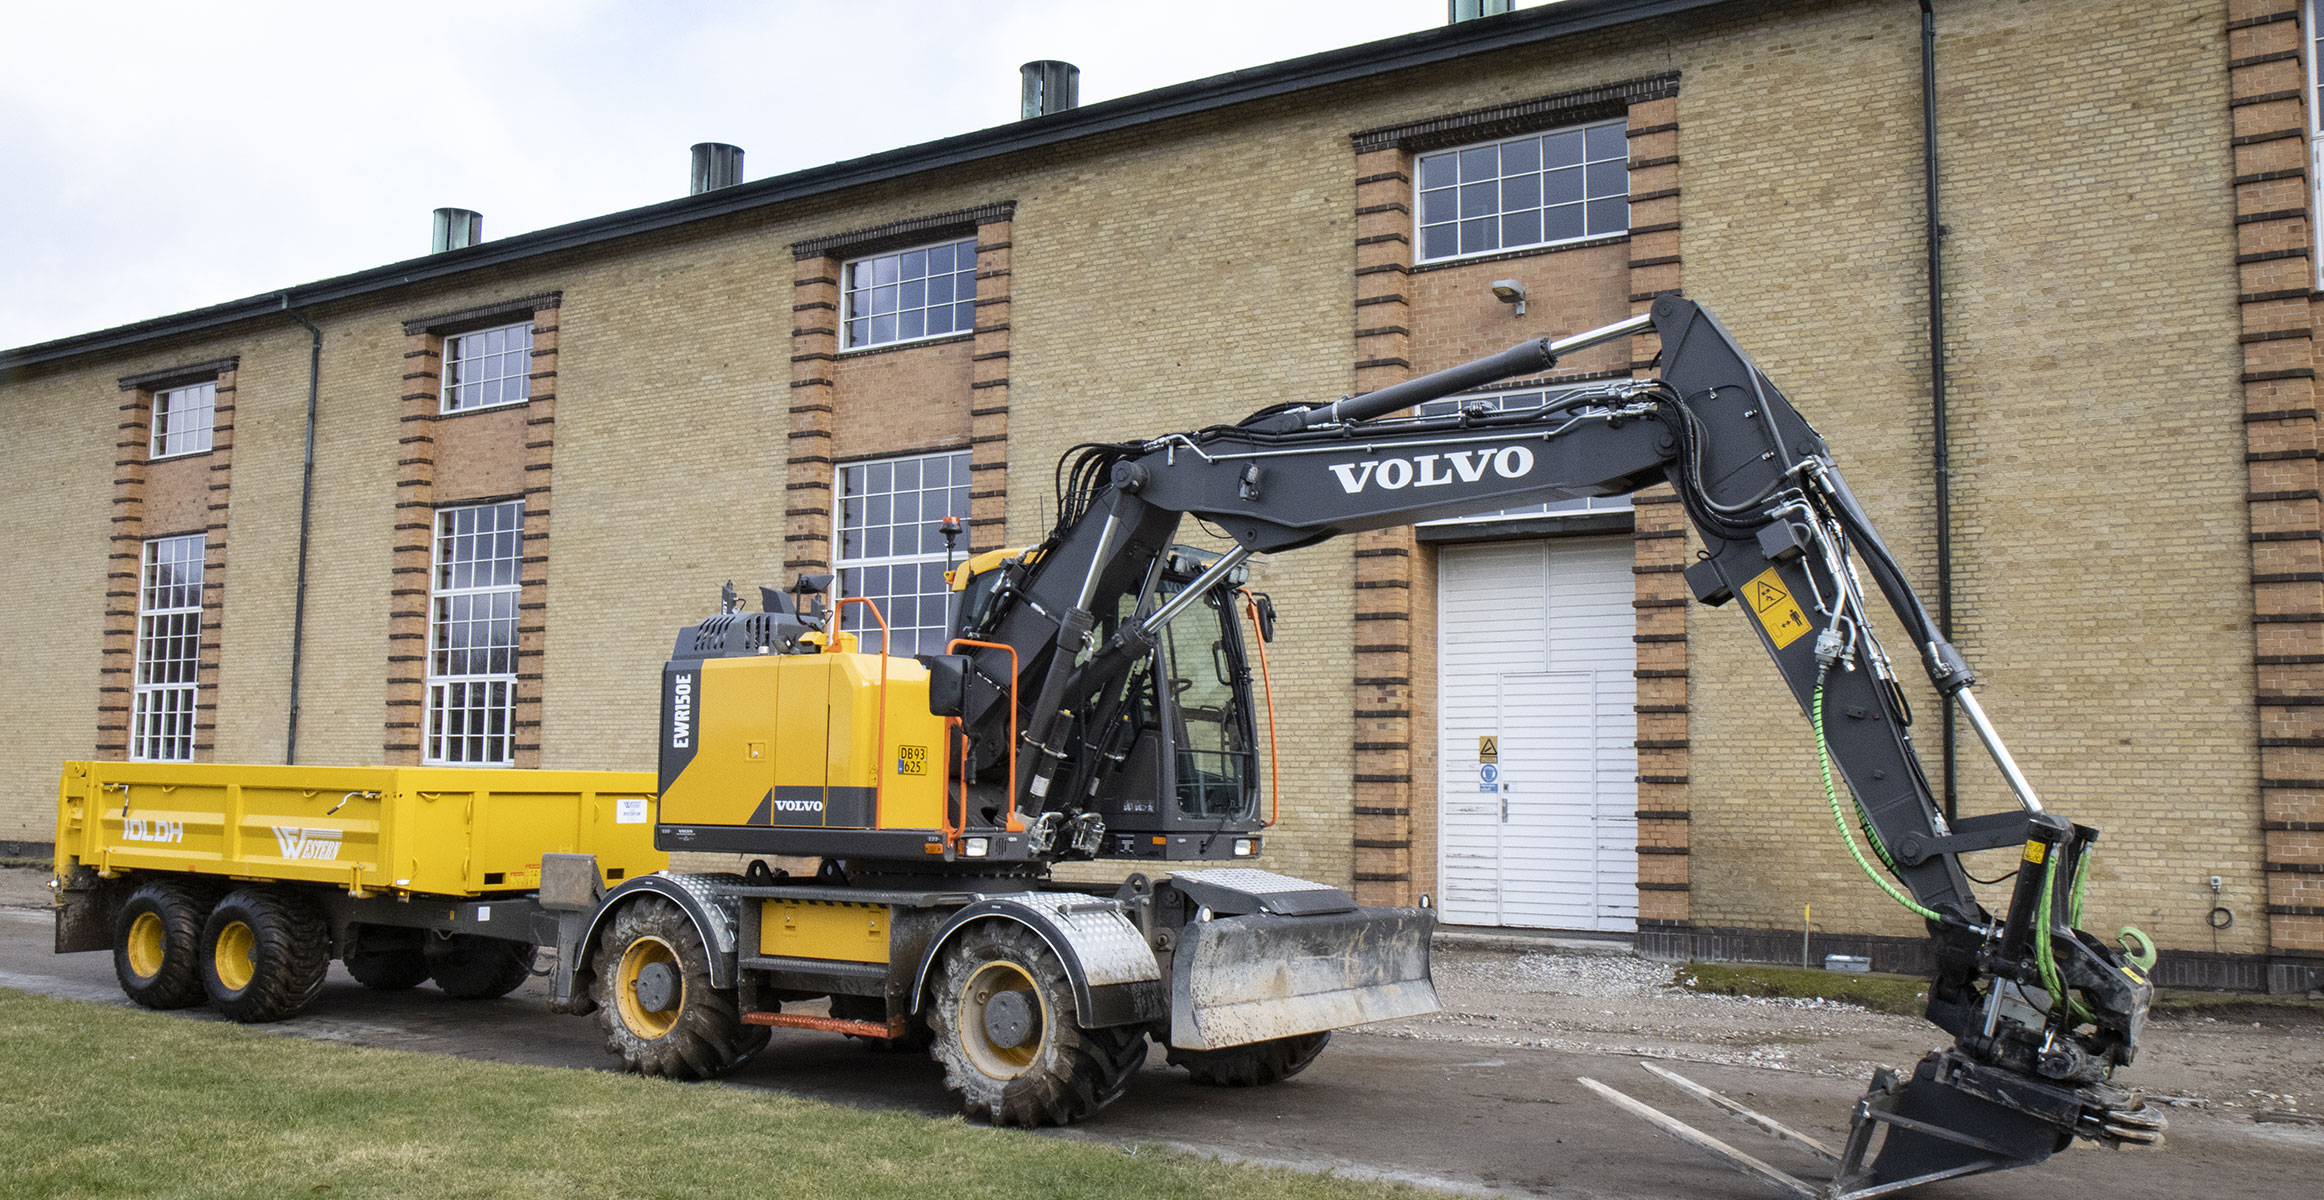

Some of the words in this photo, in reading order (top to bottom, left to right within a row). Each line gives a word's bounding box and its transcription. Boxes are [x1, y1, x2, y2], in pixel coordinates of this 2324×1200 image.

[1328, 445, 1534, 494] VOLVO
[673, 674, 691, 748] EWR150E
[901, 747, 925, 760] DB93
[904, 761, 921, 773] 625
[774, 800, 823, 811] VOLVO
